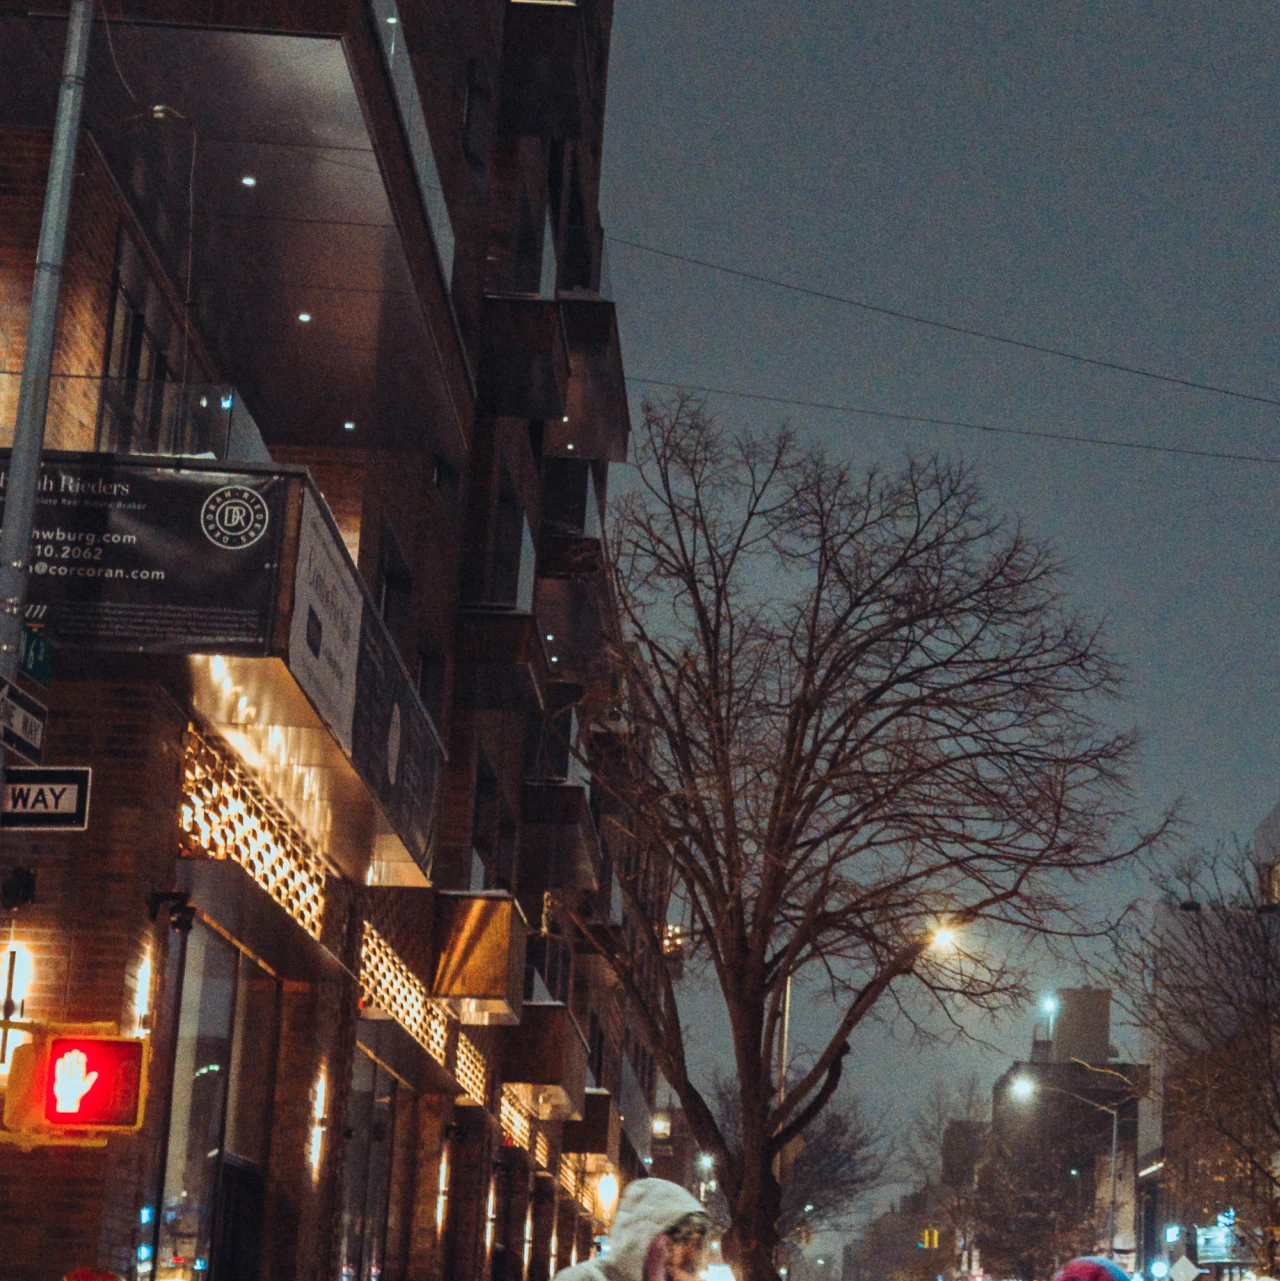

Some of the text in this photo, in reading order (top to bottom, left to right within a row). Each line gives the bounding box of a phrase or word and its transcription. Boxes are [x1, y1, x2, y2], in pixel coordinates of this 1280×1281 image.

[60, 472, 130, 496] Rieders
[116, 500, 148, 511] Broker
[31, 527, 137, 546] hwburg.com
[34, 544, 104, 561] 10.2062
[11, 787, 67, 810] WAY
